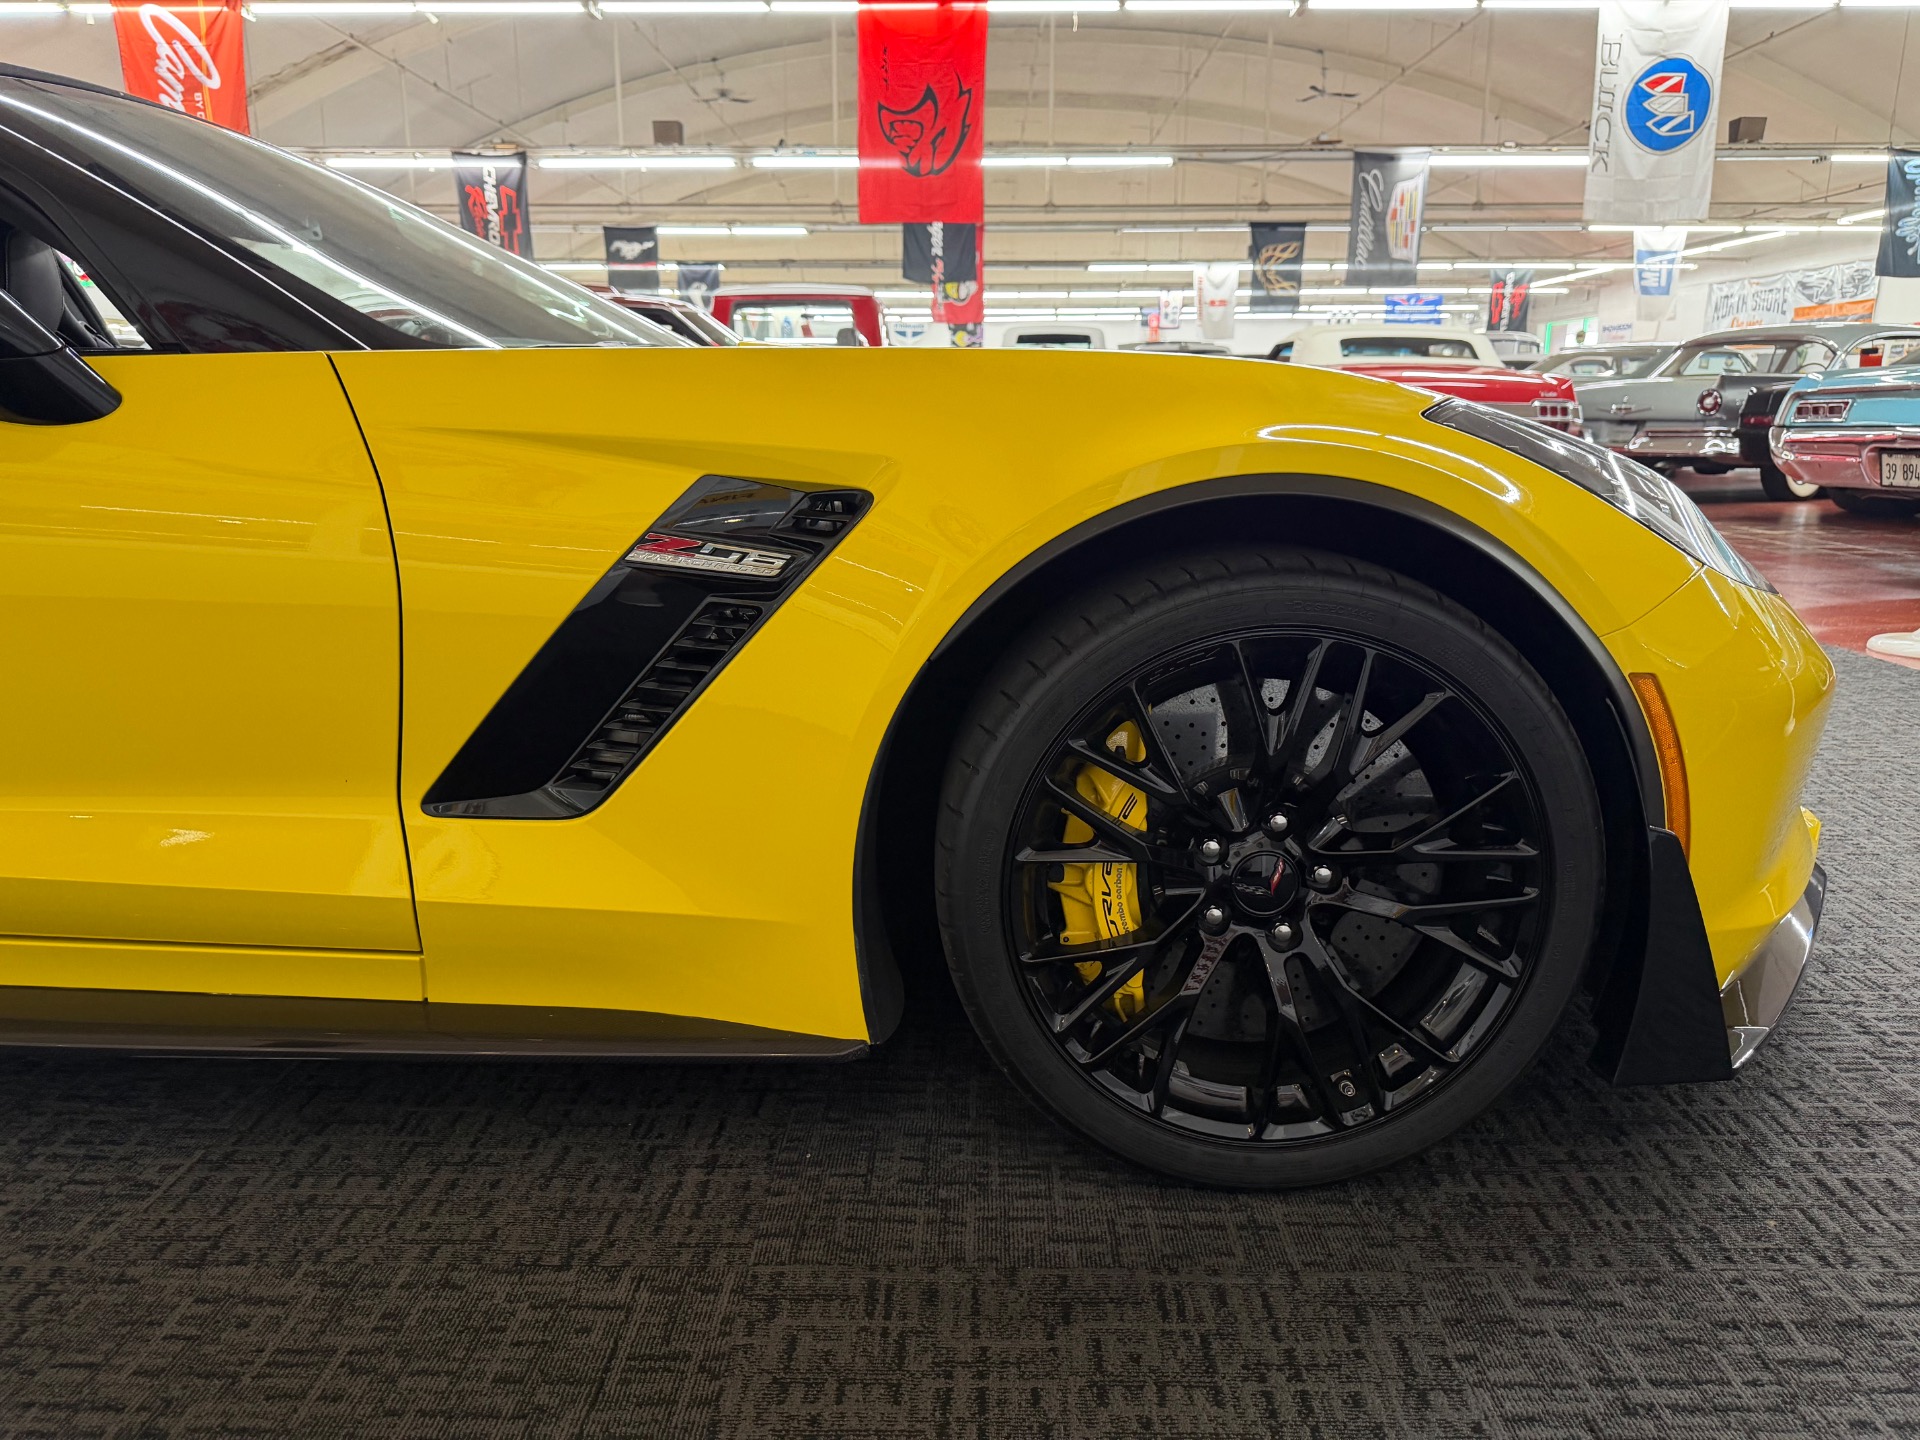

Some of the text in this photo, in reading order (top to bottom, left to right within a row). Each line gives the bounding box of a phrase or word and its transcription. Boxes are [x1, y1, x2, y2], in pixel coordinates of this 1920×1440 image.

[193, 92, 205, 109] BY
[1591, 33, 1623, 173] BUICK
[482, 166, 501, 246] CHEVRO
[1354, 168, 1385, 270] Cadillac
[1711, 292, 1748, 323] NORTH
[1751, 287, 1788, 316] SHORE
[1885, 463, 1920, 481] 39 894
[634, 532, 792, 570] Z06
[1113, 867, 1123, 900] carbon
